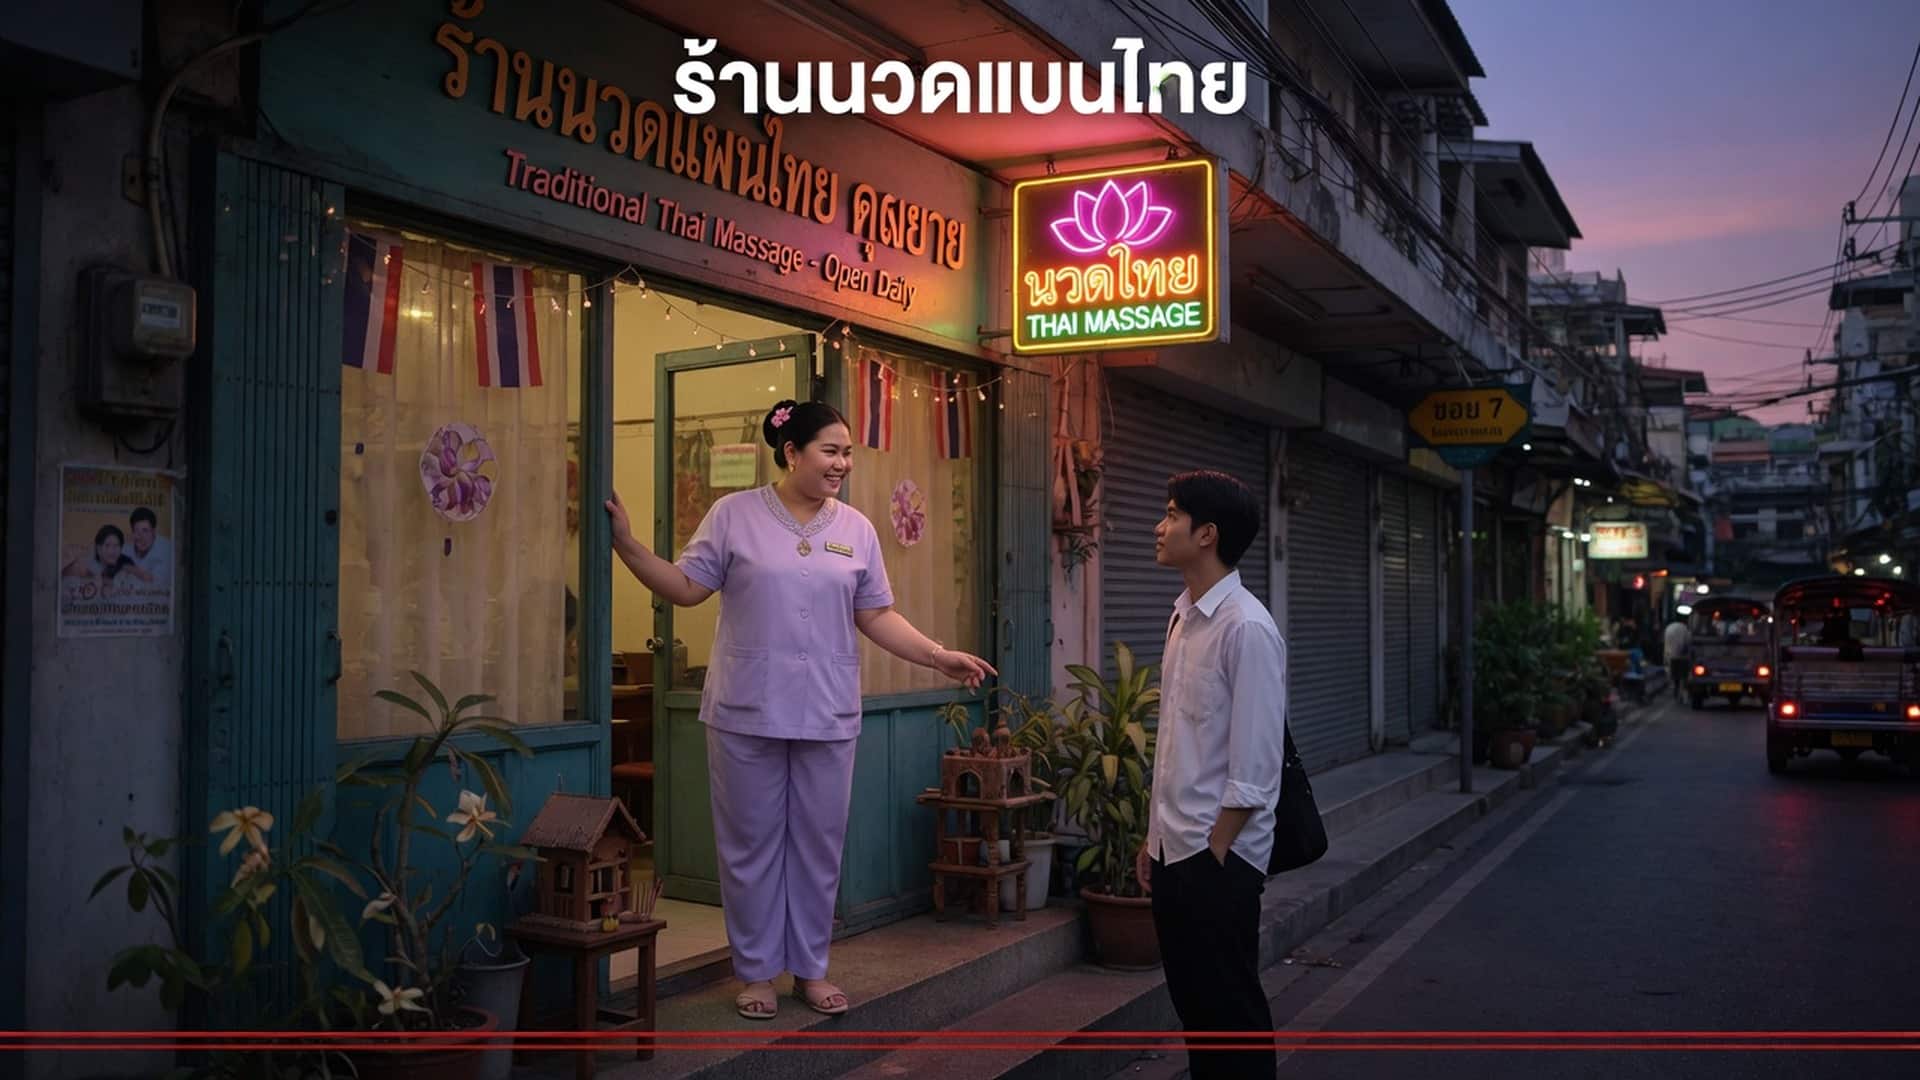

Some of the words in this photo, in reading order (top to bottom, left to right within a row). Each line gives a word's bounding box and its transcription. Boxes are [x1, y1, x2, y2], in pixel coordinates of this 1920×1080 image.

[505, 150, 648, 225] Traditional
[658, 199, 706, 241] Thai
[714, 217, 803, 276] Massage
[824, 254, 870, 294] Open
[878, 270, 917, 311] Daily
[1024, 243, 1199, 307] นวดไทย
[1026, 311, 1078, 338] THAI
[1085, 302, 1201, 334] MASSAGE
[1488, 397, 1504, 419] 7
